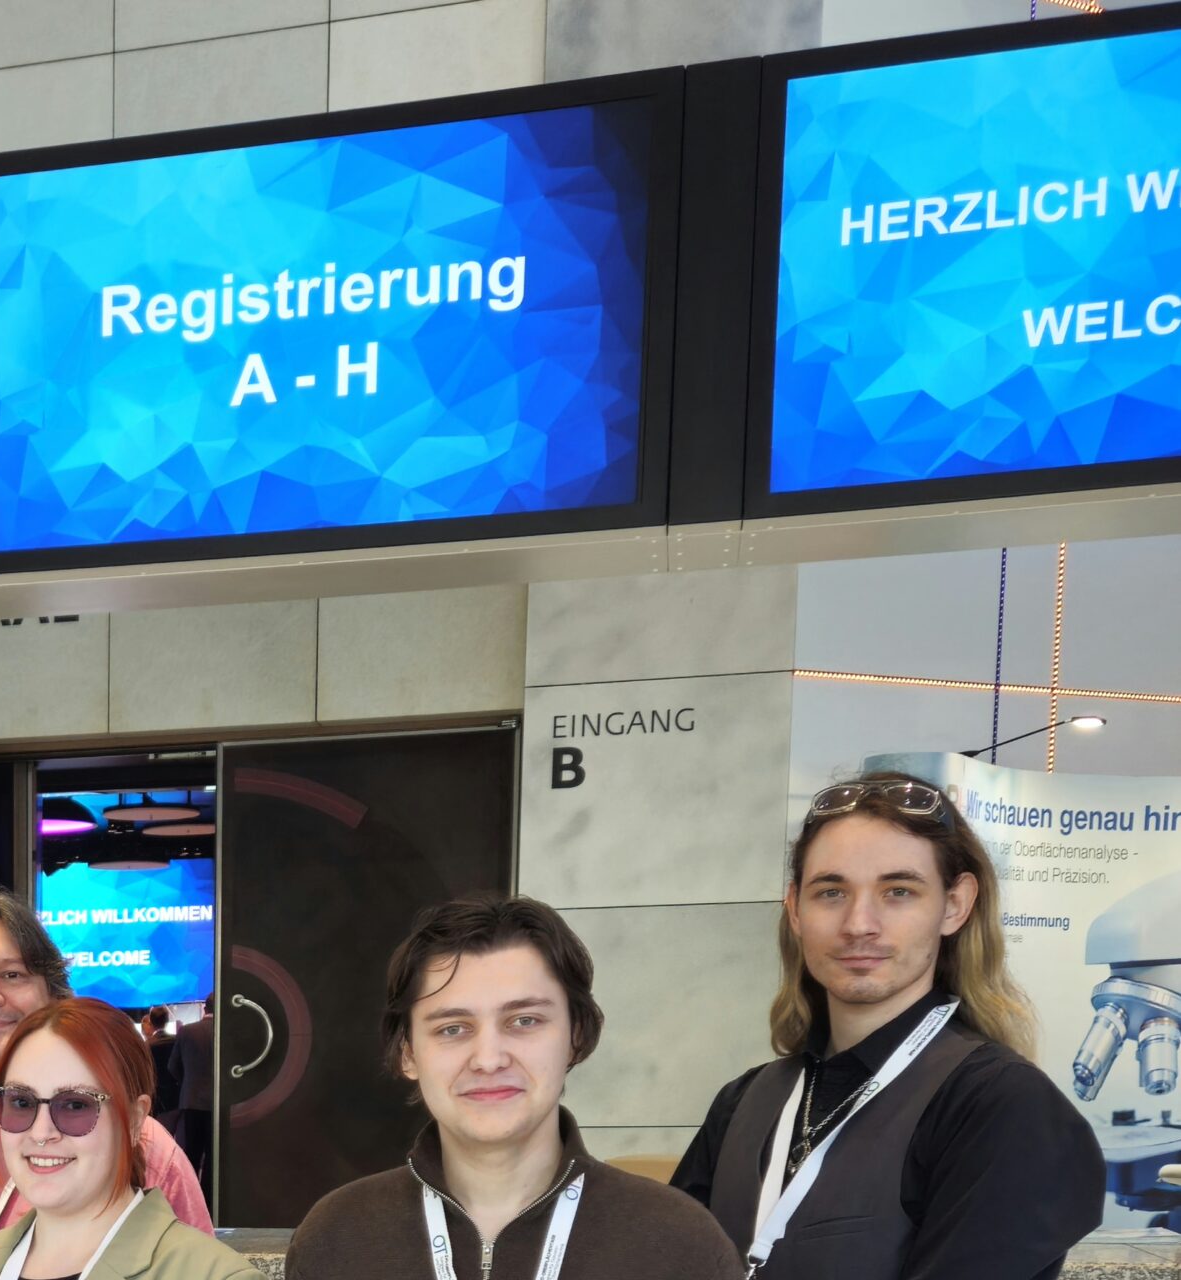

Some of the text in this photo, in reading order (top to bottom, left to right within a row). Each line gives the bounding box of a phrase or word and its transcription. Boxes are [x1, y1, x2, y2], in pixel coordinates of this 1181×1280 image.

[841, 167, 1181, 246] HERZLICH W
[101, 256, 526, 343] Registrierung
[229, 353, 278, 407] A
[336, 342, 378, 397] H
[552, 707, 695, 739] EINGANG
[551, 746, 586, 789] B
[966, 788, 983, 820] Wir
[984, 797, 1052, 829] schauen
[1060, 809, 1134, 836] genau
[1014, 840, 1128, 864] Oberflächenanalyse
[1028, 867, 1049, 882] und
[1052, 867, 1110, 885] Präzision.
[91, 905, 213, 924] WILLKOMMEN
